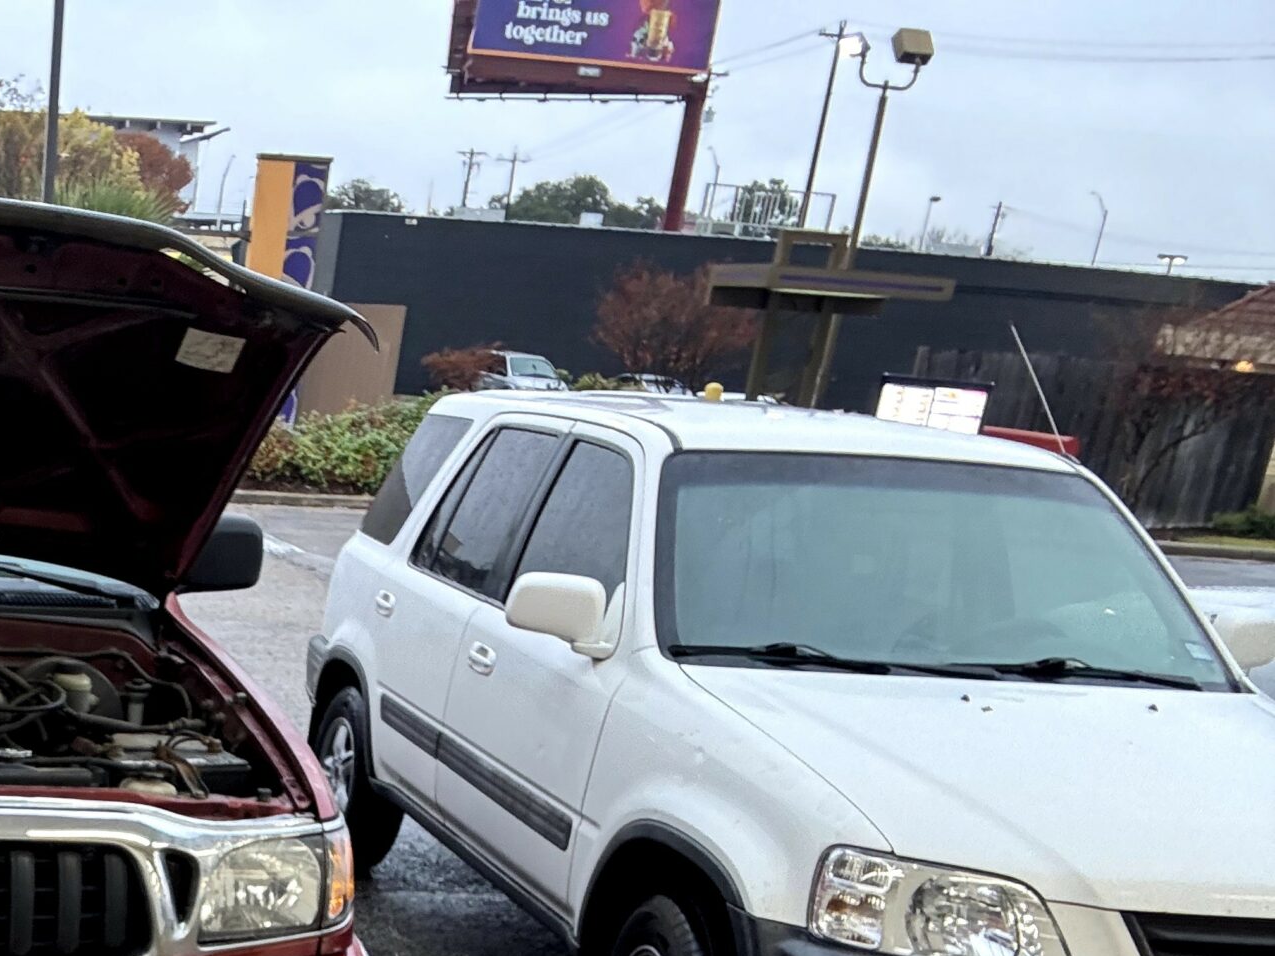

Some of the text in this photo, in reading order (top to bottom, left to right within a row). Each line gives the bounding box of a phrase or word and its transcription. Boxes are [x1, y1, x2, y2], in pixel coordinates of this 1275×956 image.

[516, 1, 610, 27] brings us
[504, 21, 588, 45] together
